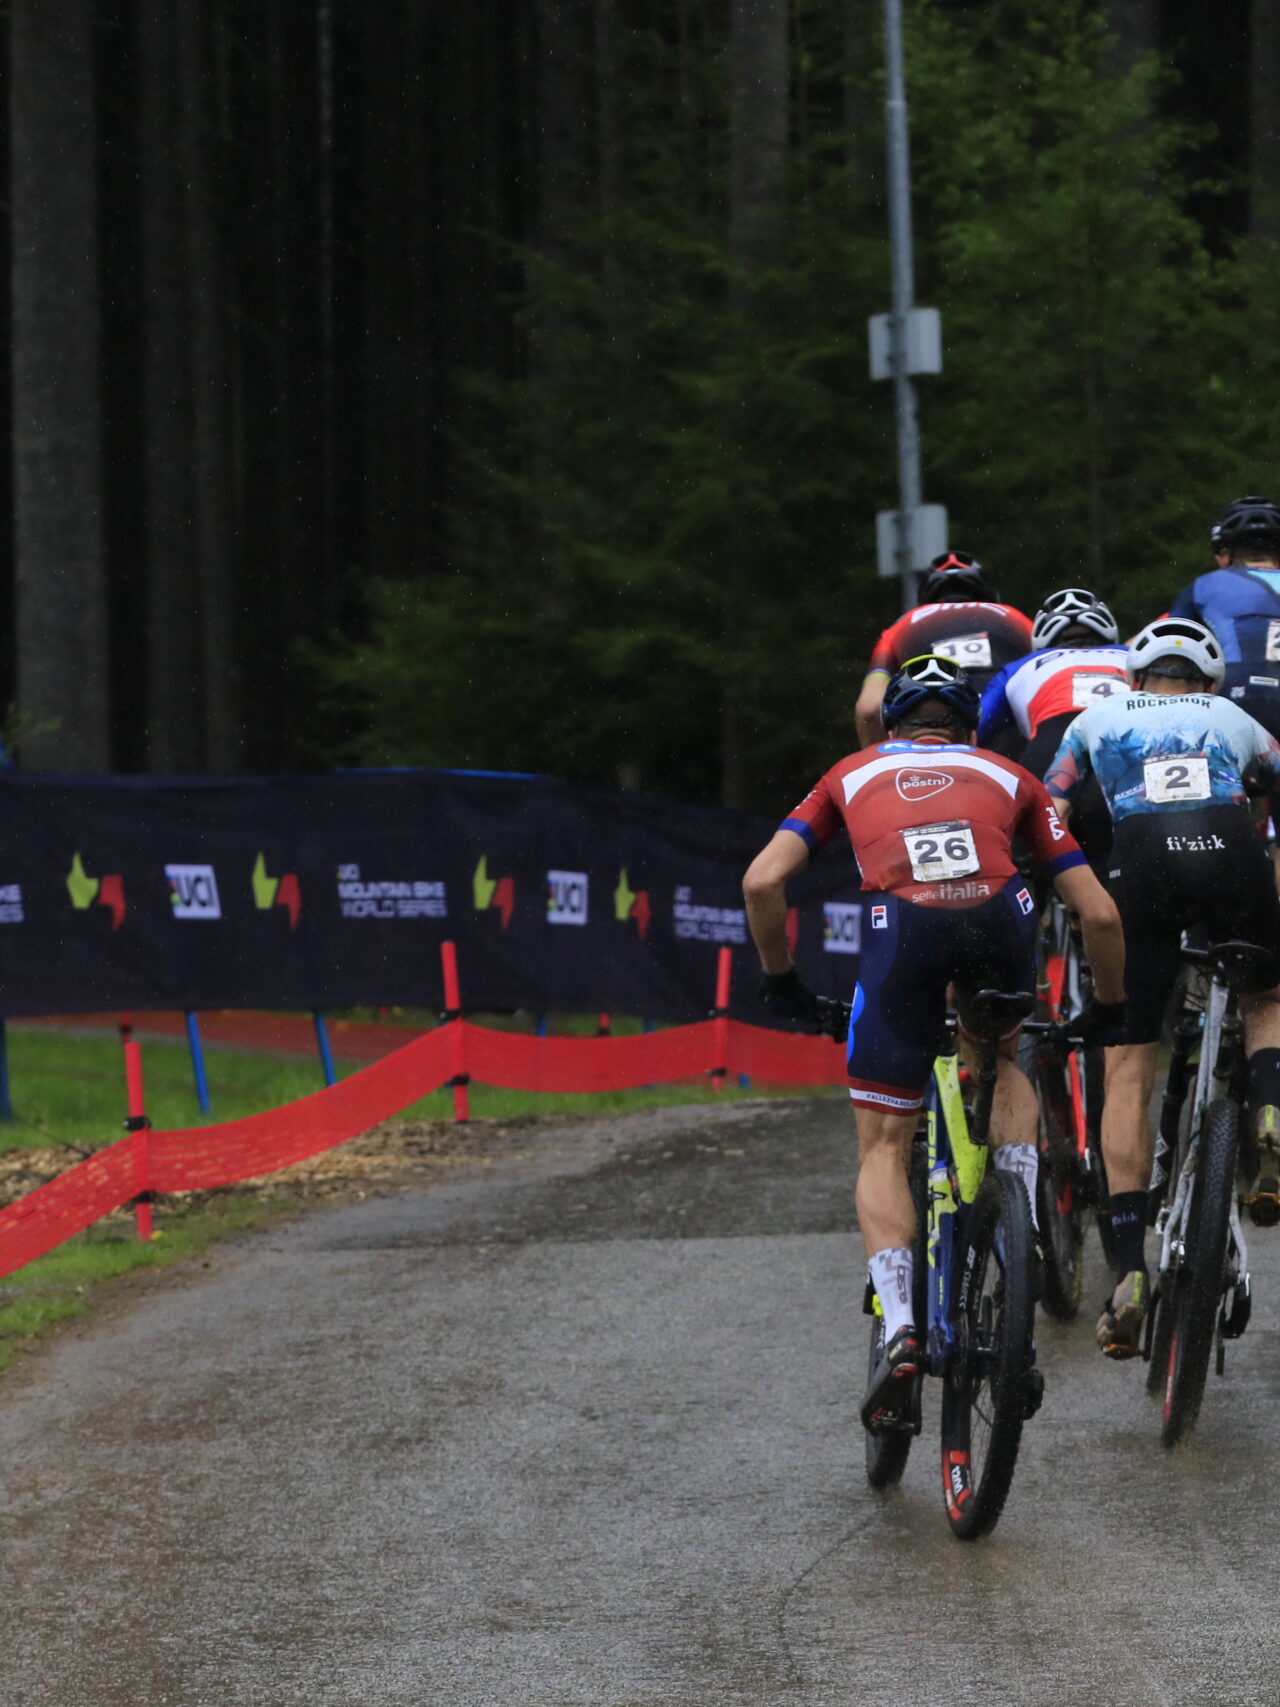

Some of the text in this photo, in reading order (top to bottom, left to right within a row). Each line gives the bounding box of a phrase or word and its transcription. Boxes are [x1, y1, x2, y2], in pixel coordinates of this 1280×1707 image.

[1091, 682, 1114, 698] 4
[1126, 697, 1211, 711] ROCKSHOX
[1164, 766, 1191, 790] 2
[1045, 806, 1066, 841] FILA
[914, 837, 970, 864] 26
